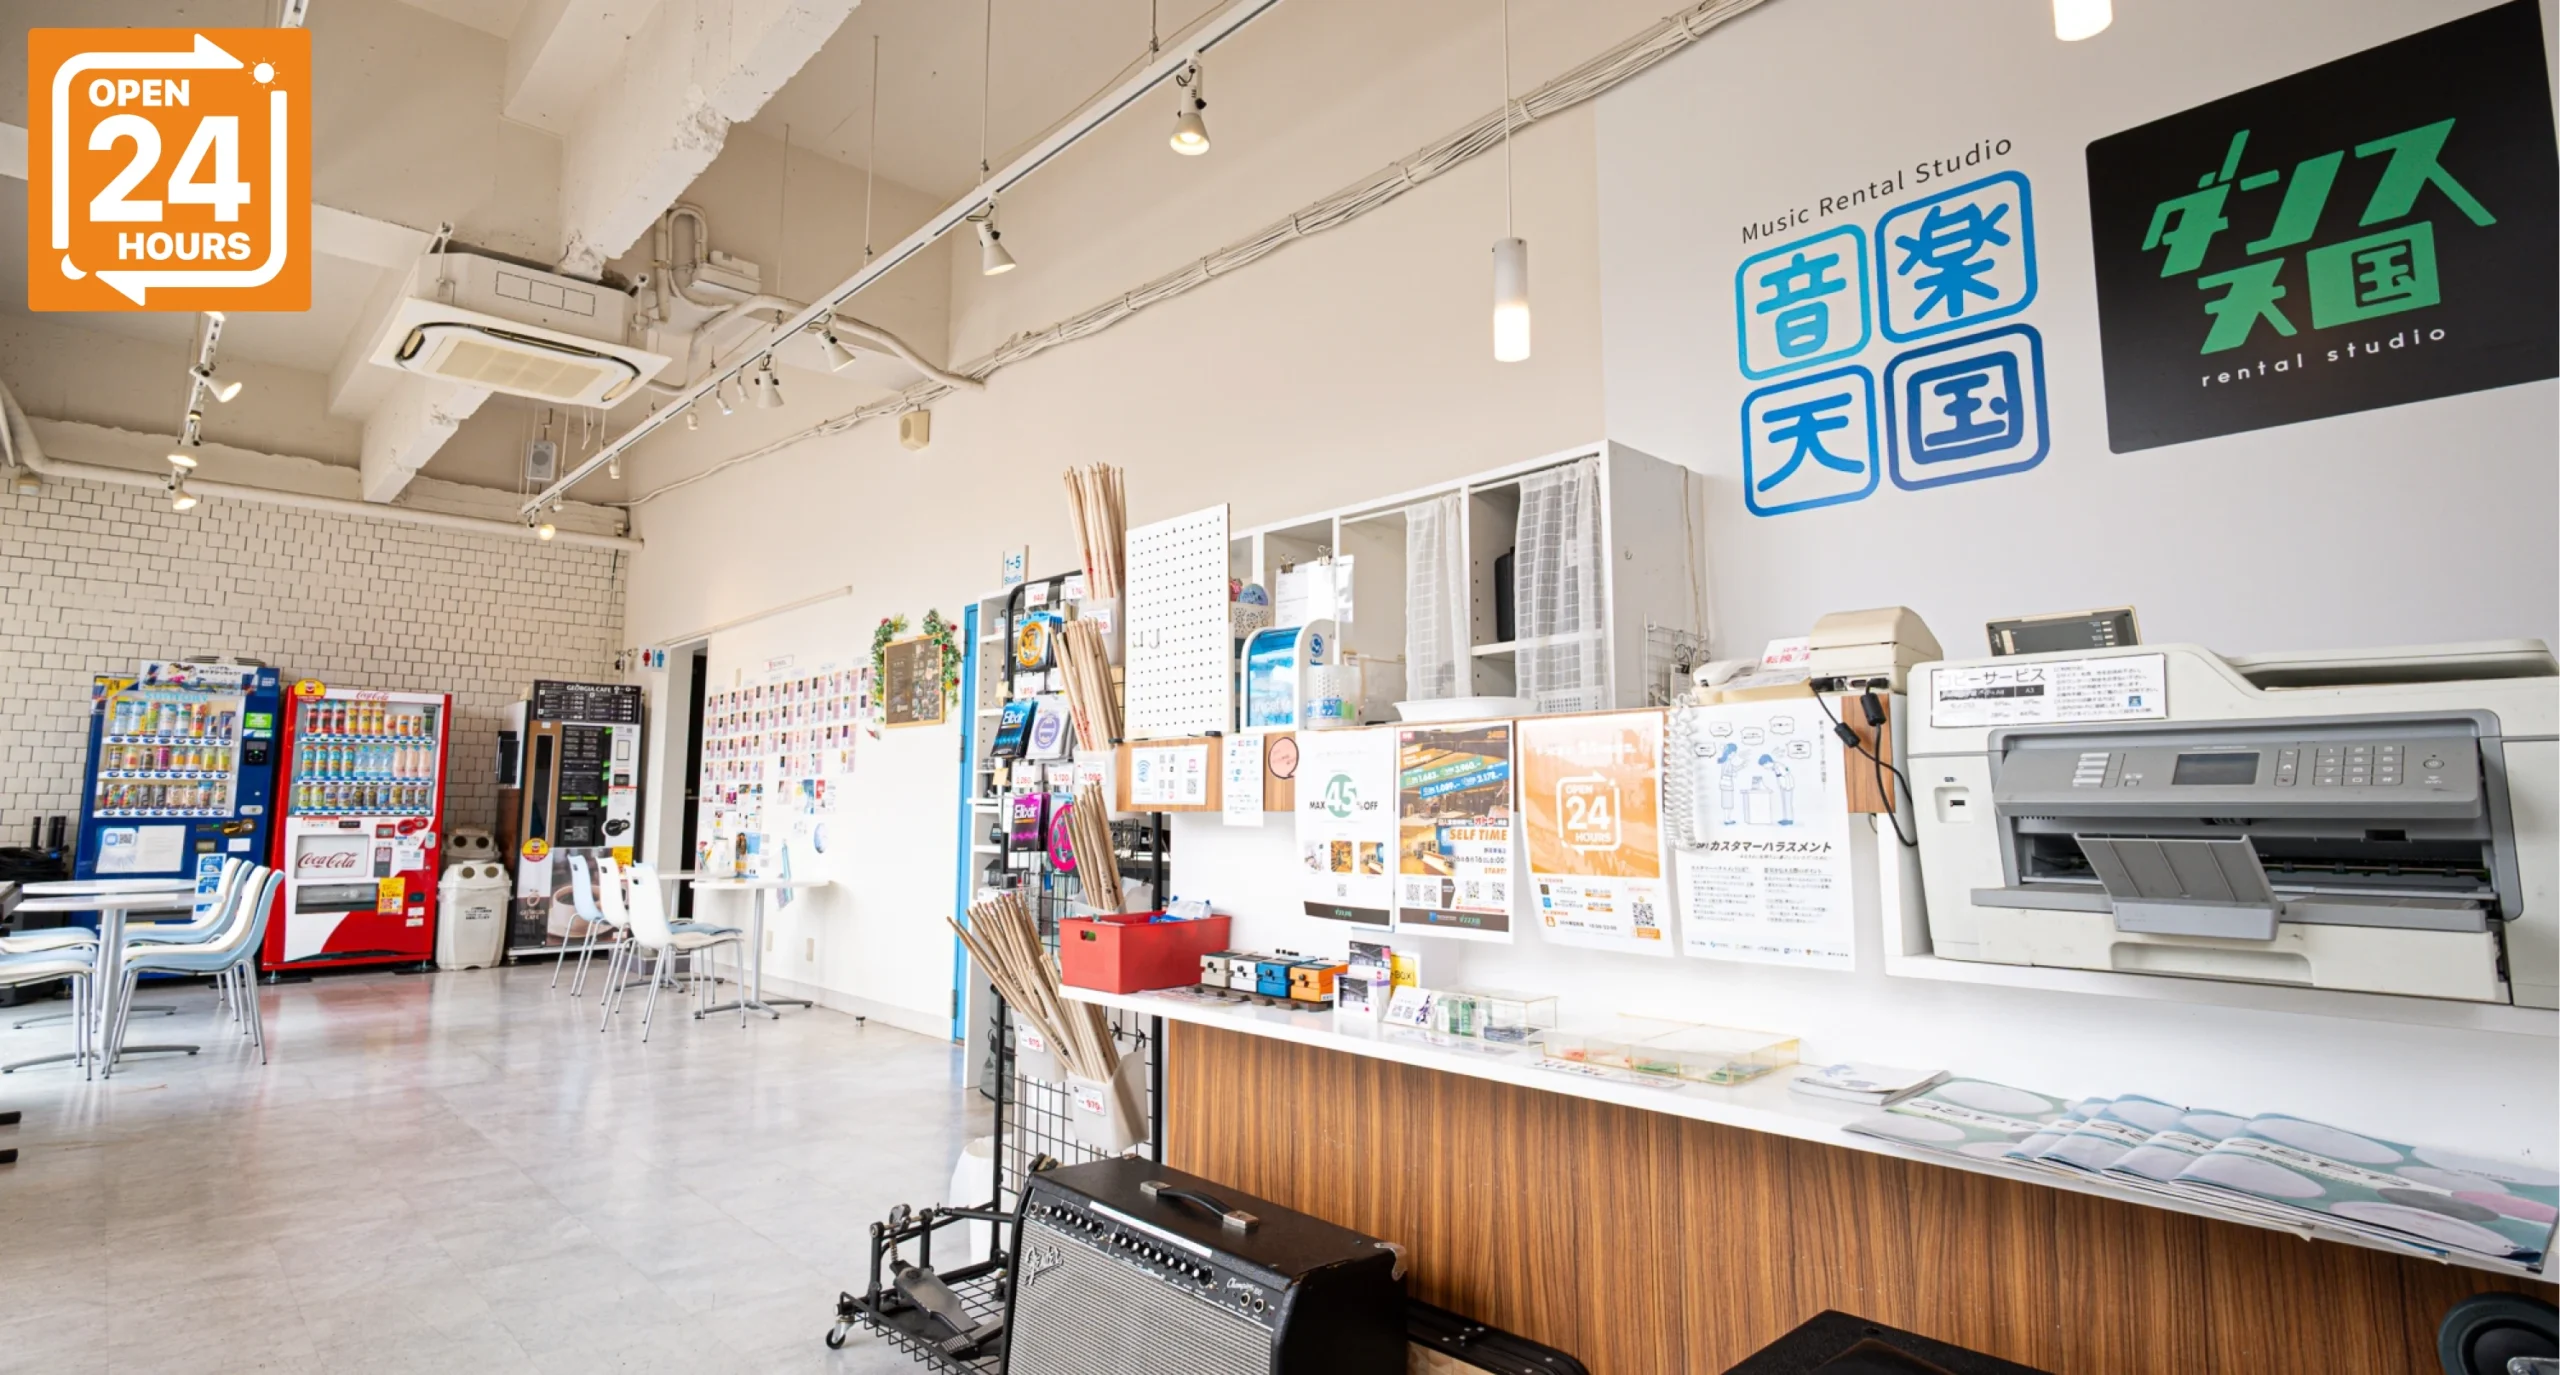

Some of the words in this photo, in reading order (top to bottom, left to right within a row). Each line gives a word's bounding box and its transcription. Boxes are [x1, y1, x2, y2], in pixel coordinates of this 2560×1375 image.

[1741, 211, 1810, 244] Music
[1819, 172, 1905, 216] Rental
[1914, 136, 2013, 185] Studio
[2141, 117, 2498, 279] ダンス
[1755, 200, 2012, 360] 音楽
[2197, 220, 2442, 355] 天国
[2201, 352, 2306, 388] rental
[2326, 325, 2448, 364] studio
[1757, 350, 2026, 494] 天国
[1002, 710, 1027, 725] Elixir
[1309, 801, 1326, 810] MAX
[1326, 778, 1358, 816] 45
[1565, 784, 1594, 794] OPEN
[1014, 803, 1038, 819] Elixir
[1565, 795, 1612, 831] 24
[1449, 828, 1475, 841] SELF
[1479, 829, 1508, 841] TIME
[1575, 832, 1612, 843] HOURS
[1710, 840, 1833, 854] カスタマーハラスメント
[297, 852, 358, 869] Coca-Cola
